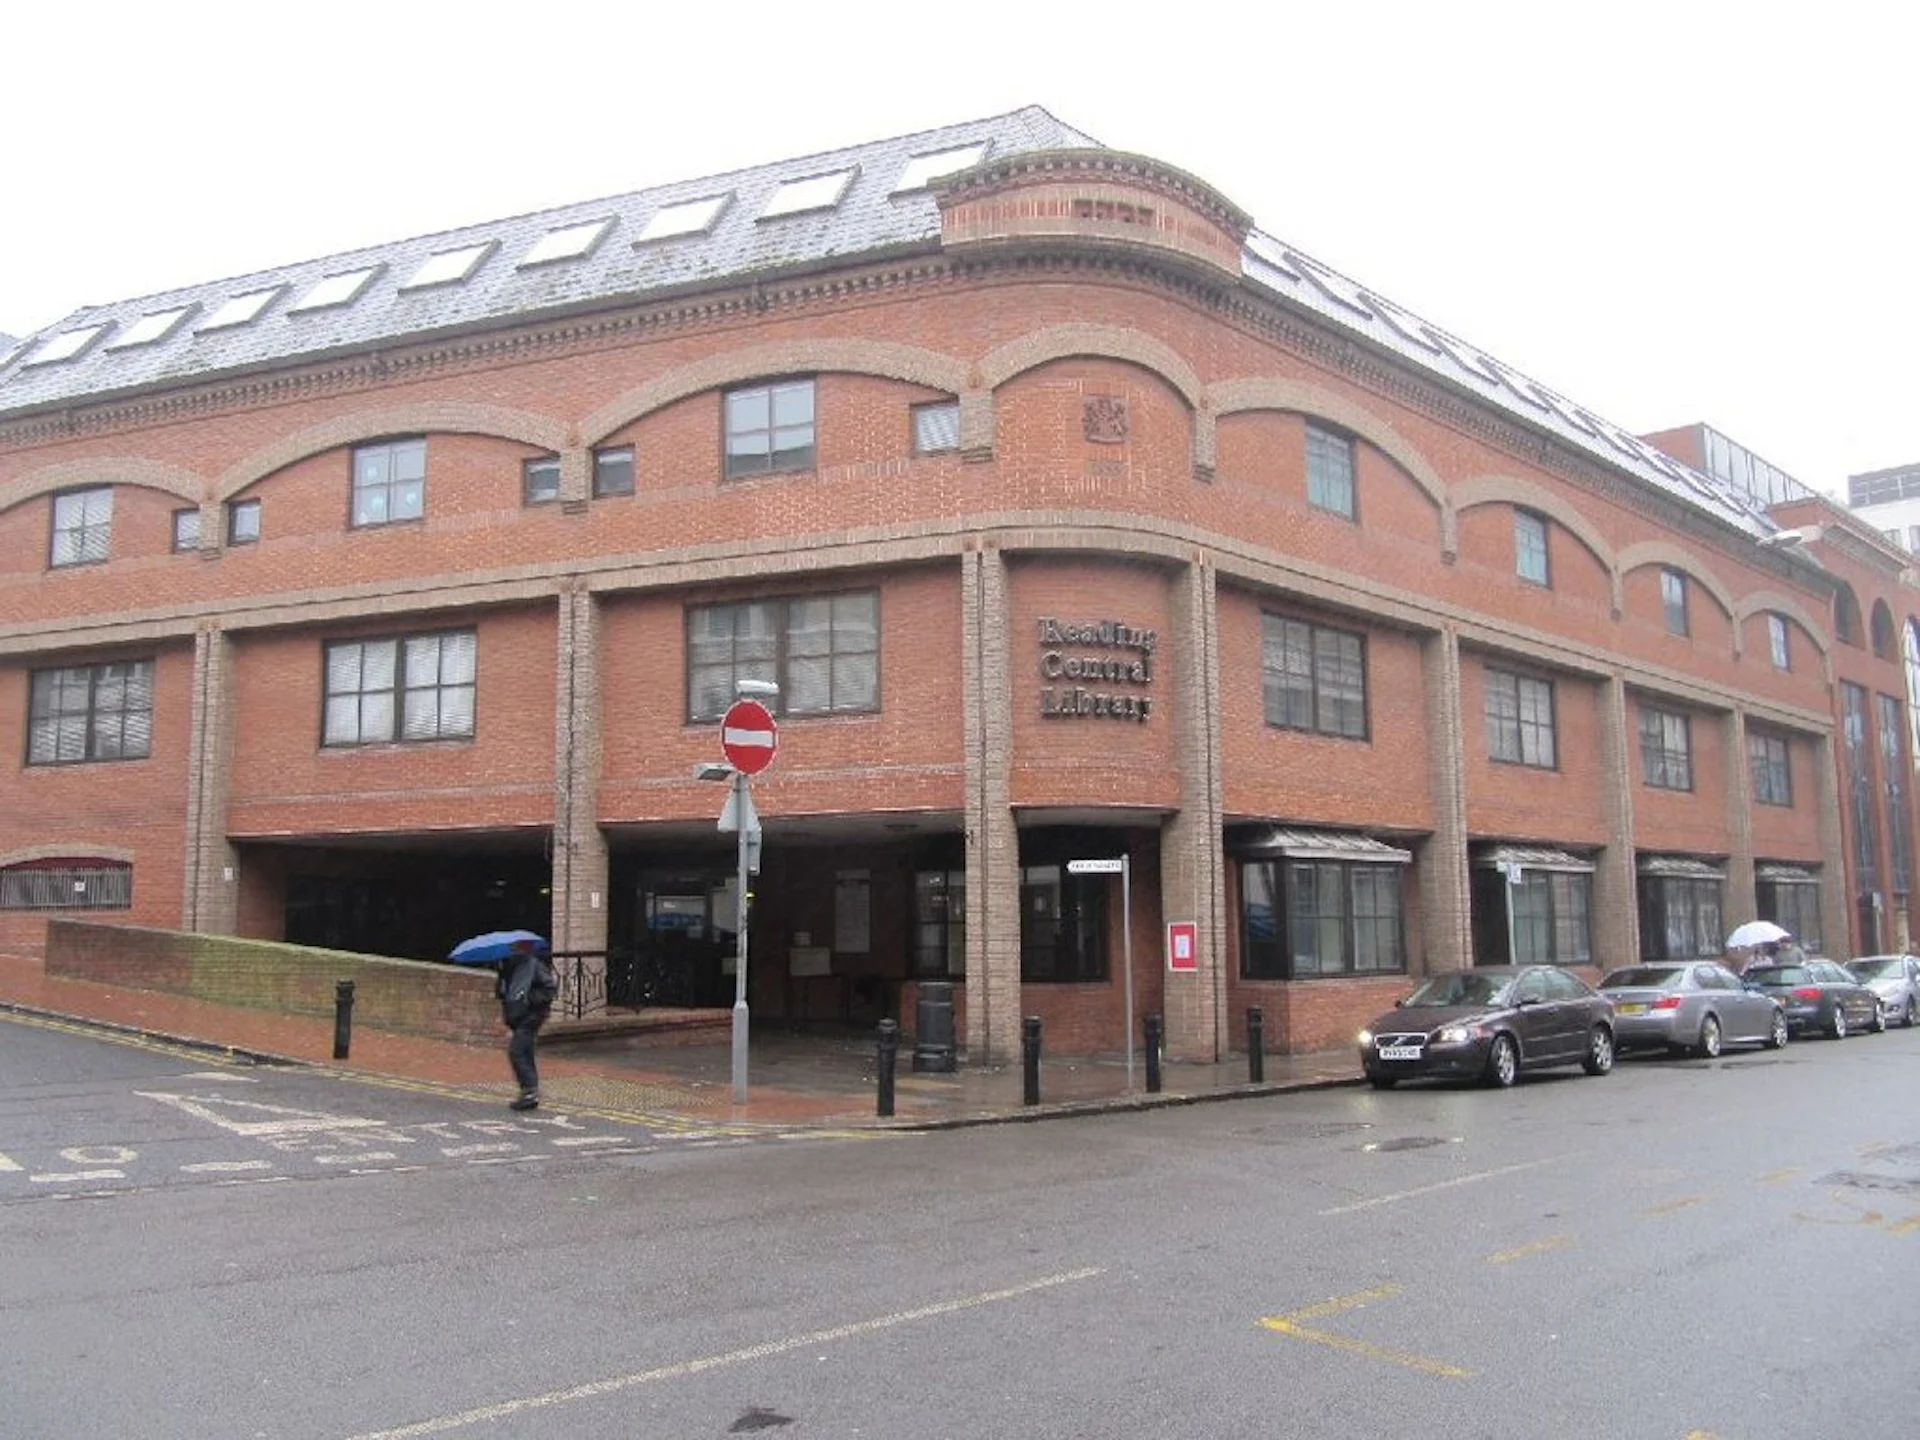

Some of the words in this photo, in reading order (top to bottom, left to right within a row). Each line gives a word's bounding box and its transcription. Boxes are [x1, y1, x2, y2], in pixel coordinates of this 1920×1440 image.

[1038, 616, 1157, 651] Reading
[1041, 650, 1152, 683] Central
[1040, 687, 1152, 722] Library
